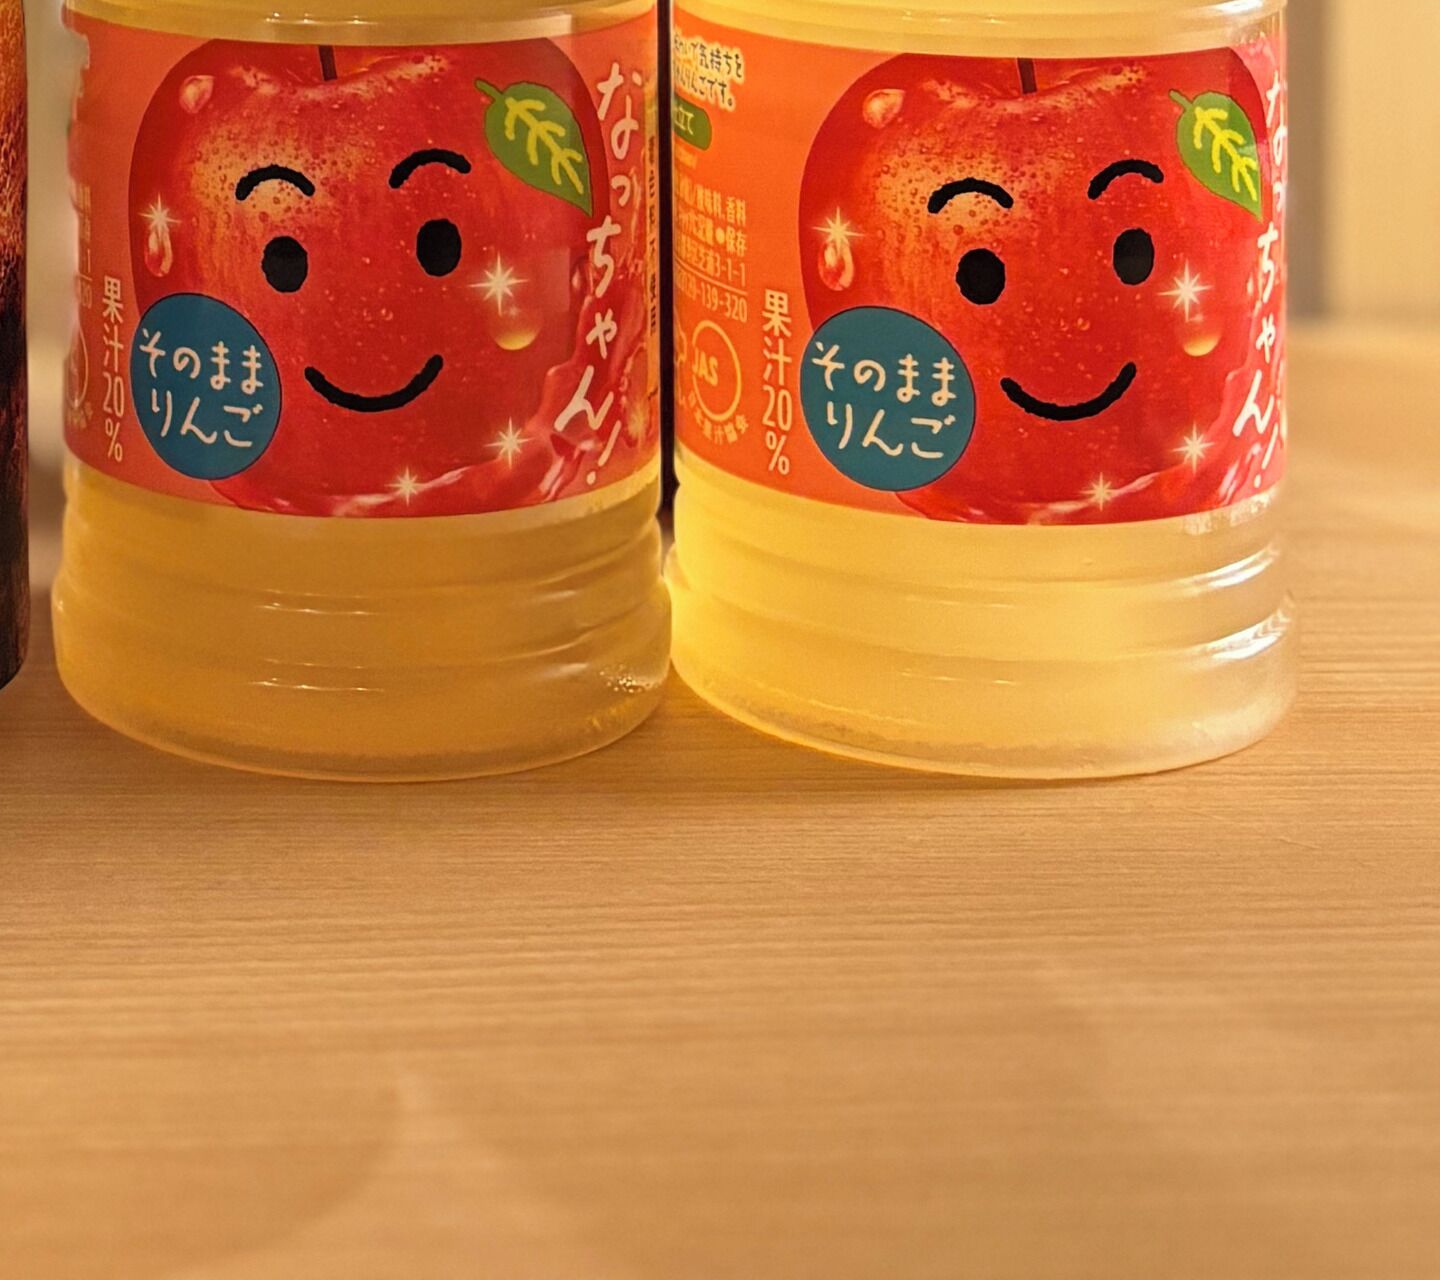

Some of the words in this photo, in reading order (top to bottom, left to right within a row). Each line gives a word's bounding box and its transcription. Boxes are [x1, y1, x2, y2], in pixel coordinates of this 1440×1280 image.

[138, 327, 264, 395] そのまま
[692, 347, 719, 387] JAS
[761, 288, 793, 476] 果汁20%
[810, 340, 957, 407] そのまま
[150, 389, 264, 449] りんご
[824, 403, 957, 460] りんご
